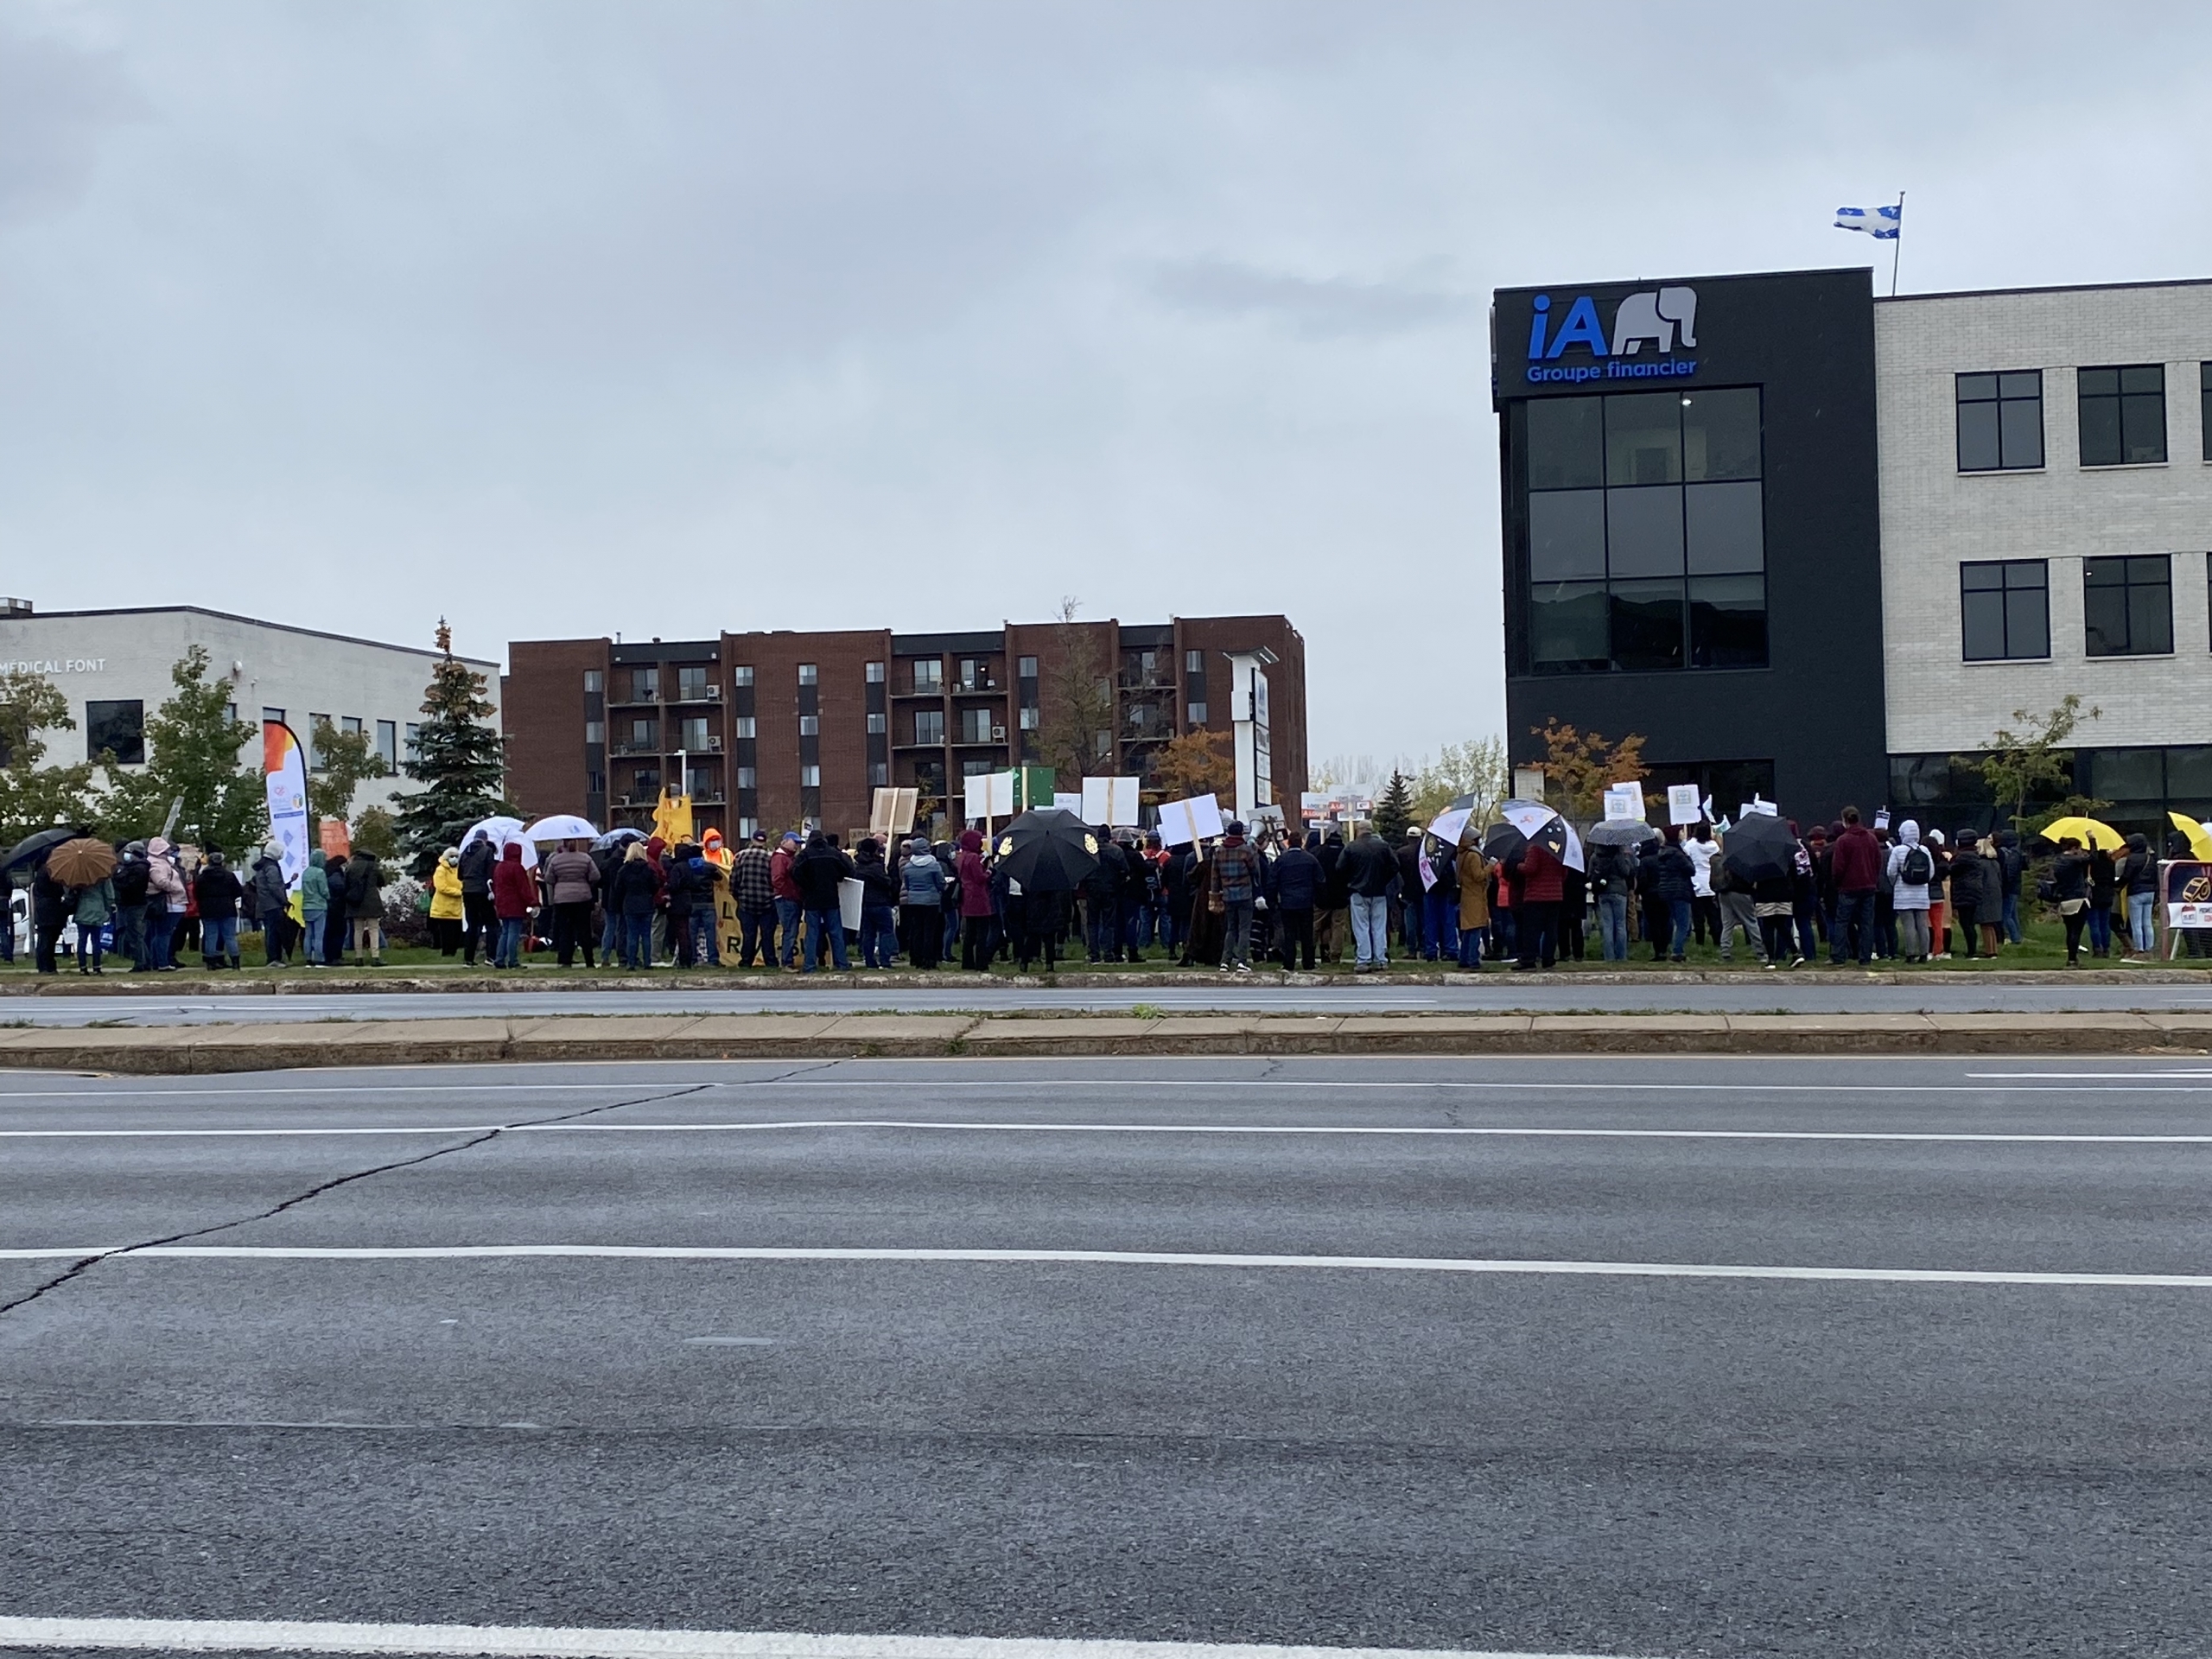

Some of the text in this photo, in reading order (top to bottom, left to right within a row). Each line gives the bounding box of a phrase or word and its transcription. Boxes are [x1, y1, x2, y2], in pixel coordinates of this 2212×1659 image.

[1528, 294, 1608, 359] iA
[1527, 358, 1698, 383] Groupe financier
[66, 658, 105, 673] FONT
